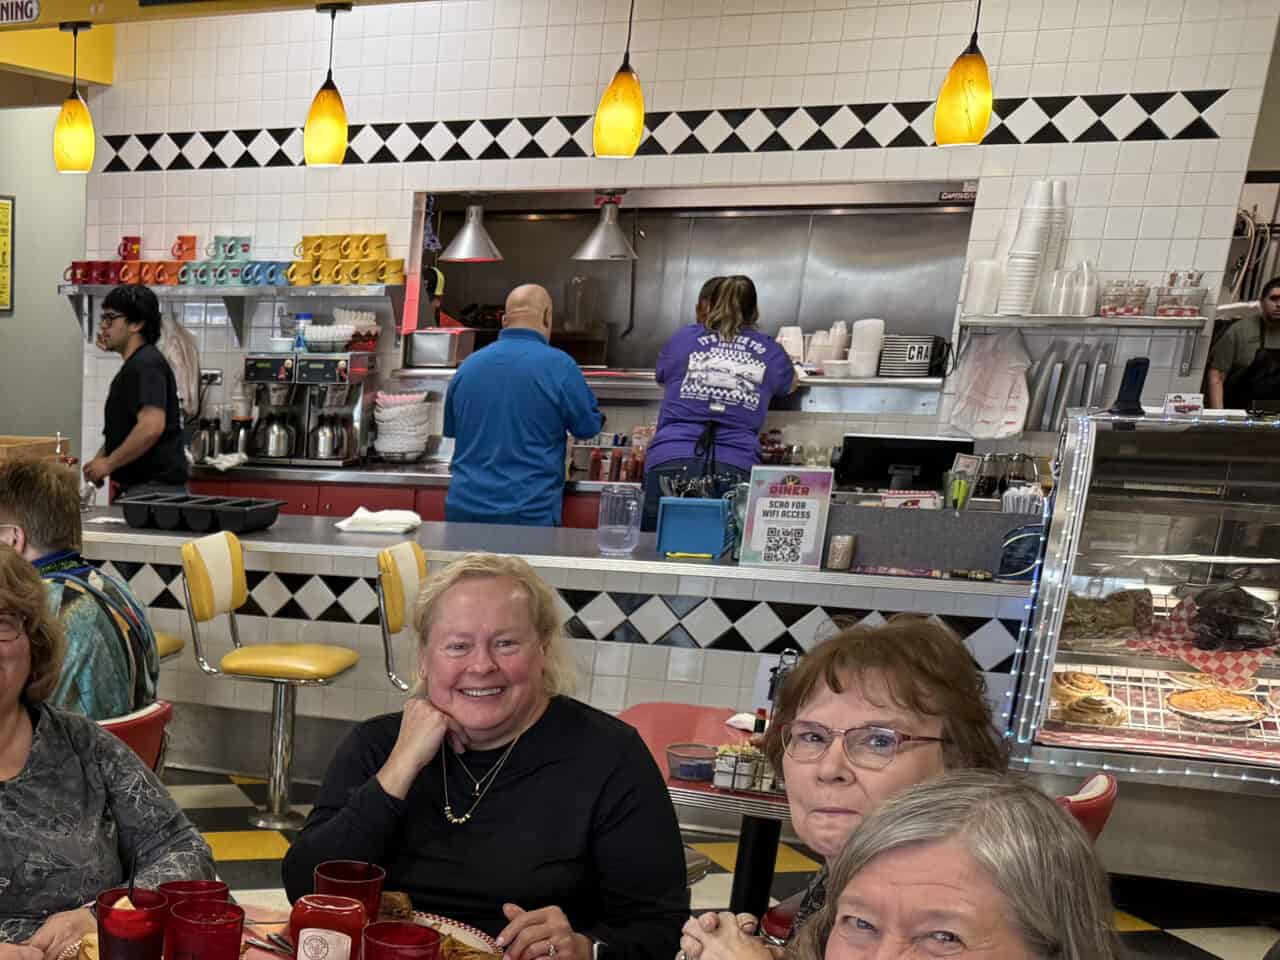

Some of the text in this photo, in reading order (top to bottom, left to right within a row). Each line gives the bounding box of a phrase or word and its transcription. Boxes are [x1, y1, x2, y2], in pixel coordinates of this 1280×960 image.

[768, 485, 810, 497] DINER
[769, 500, 807, 510] SCAN FOR
[781, 511, 810, 519] ACCESS
